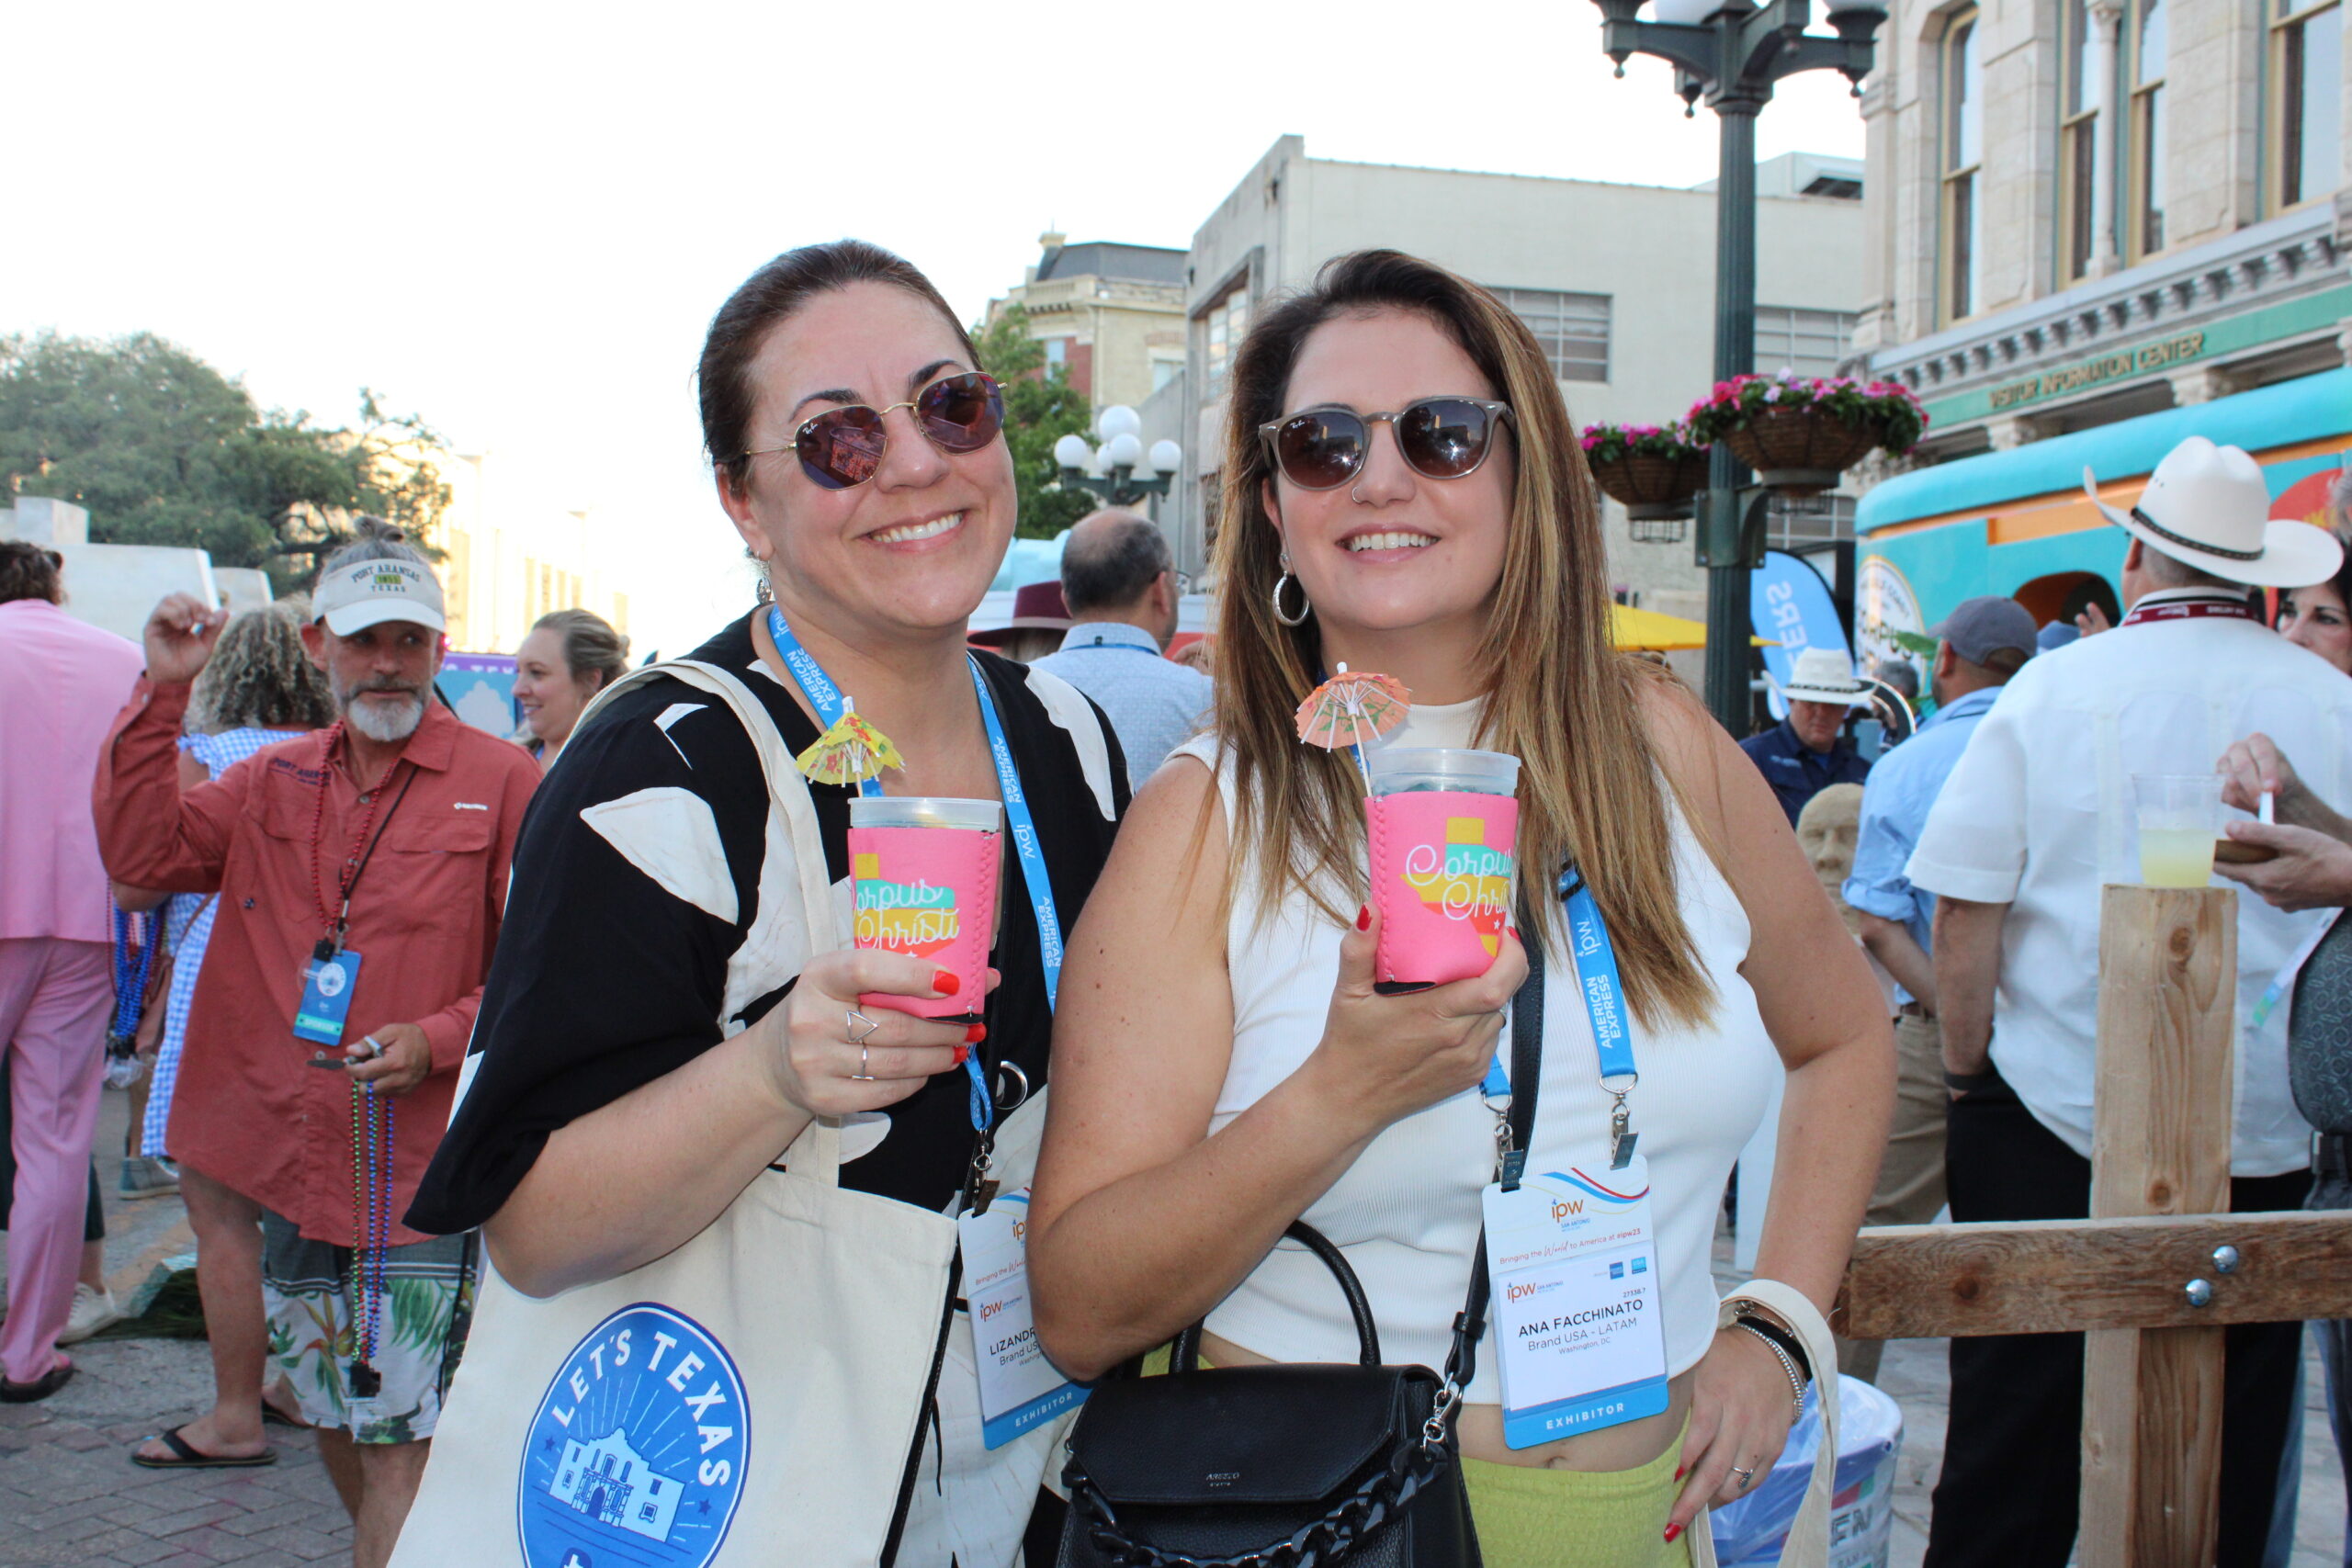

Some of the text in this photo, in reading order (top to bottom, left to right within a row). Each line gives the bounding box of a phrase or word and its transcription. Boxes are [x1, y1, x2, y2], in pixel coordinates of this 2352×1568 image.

[1988, 331, 2205, 409] VISITOR INFORMATION CENTER
[787, 650, 832, 712] AMERICAN
[993, 743, 1014, 804] EXPRESS
[996, 736, 1022, 803] AMERICAN
[1406, 844, 1512, 886] Corpu
[851, 878, 944, 917] orpus
[1037, 905, 1054, 967] EXPRESS
[1043, 897, 1061, 967] AMERICAN
[1577, 920, 1601, 957] ipw
[1586, 976, 1612, 1048] AMERICAN
[1598, 974, 1622, 1039] EXPRESS
[1552, 1198, 1583, 1224] ipw
[1012, 1220, 1026, 1241] ip
[1499, 1252, 1530, 1265] Bringing
[1531, 1249, 1543, 1258] the
[1579, 1235, 1608, 1247] America
[1508, 1281, 1536, 1303] ipw
[979, 1301, 1002, 1322] ipw
[1519, 1299, 1643, 1337] ANA FACCHINATO
[989, 1327, 1036, 1356] LIZANDR
[1000, 1340, 1039, 1366] Brand US
[1528, 1336, 1561, 1352] Brand
[1564, 1329, 1589, 1343] USA
[1599, 1317, 1637, 1336] LATAM
[1600, 1337, 1611, 1345] DC
[552, 1329, 733, 1486] LET'S TEXAS
[1015, 1392, 1073, 1427] EXHIBITOR
[1546, 1403, 1624, 1430] EXHIBITOR
